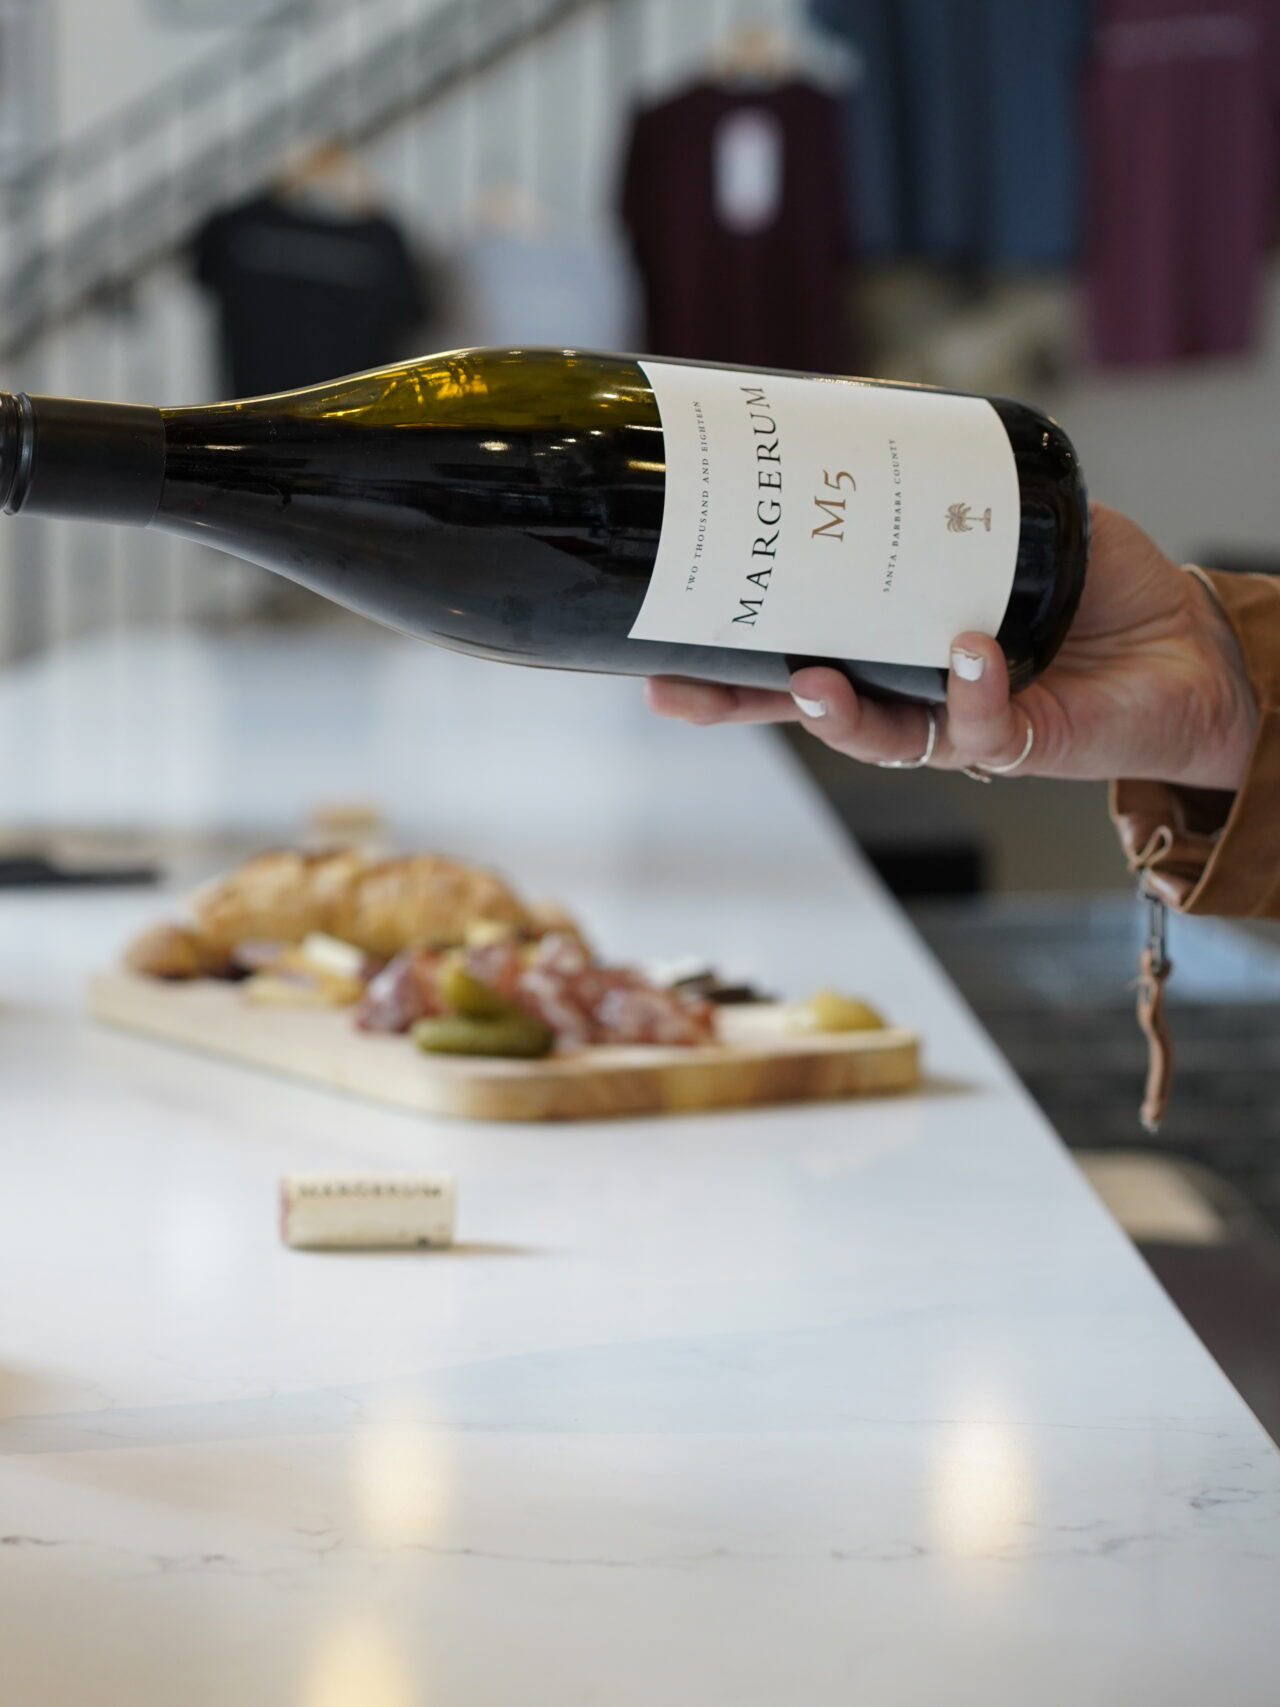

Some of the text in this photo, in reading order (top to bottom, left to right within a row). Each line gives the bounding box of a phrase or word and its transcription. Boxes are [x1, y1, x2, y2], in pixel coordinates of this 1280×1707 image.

[686, 401, 710, 592] TWO THOUSAND AND EIGHTEEN
[731, 386, 782, 627] MARGERUM
[811, 469, 857, 542] M5
[882, 438, 902, 593] SANTA BARBARA COUNTY
